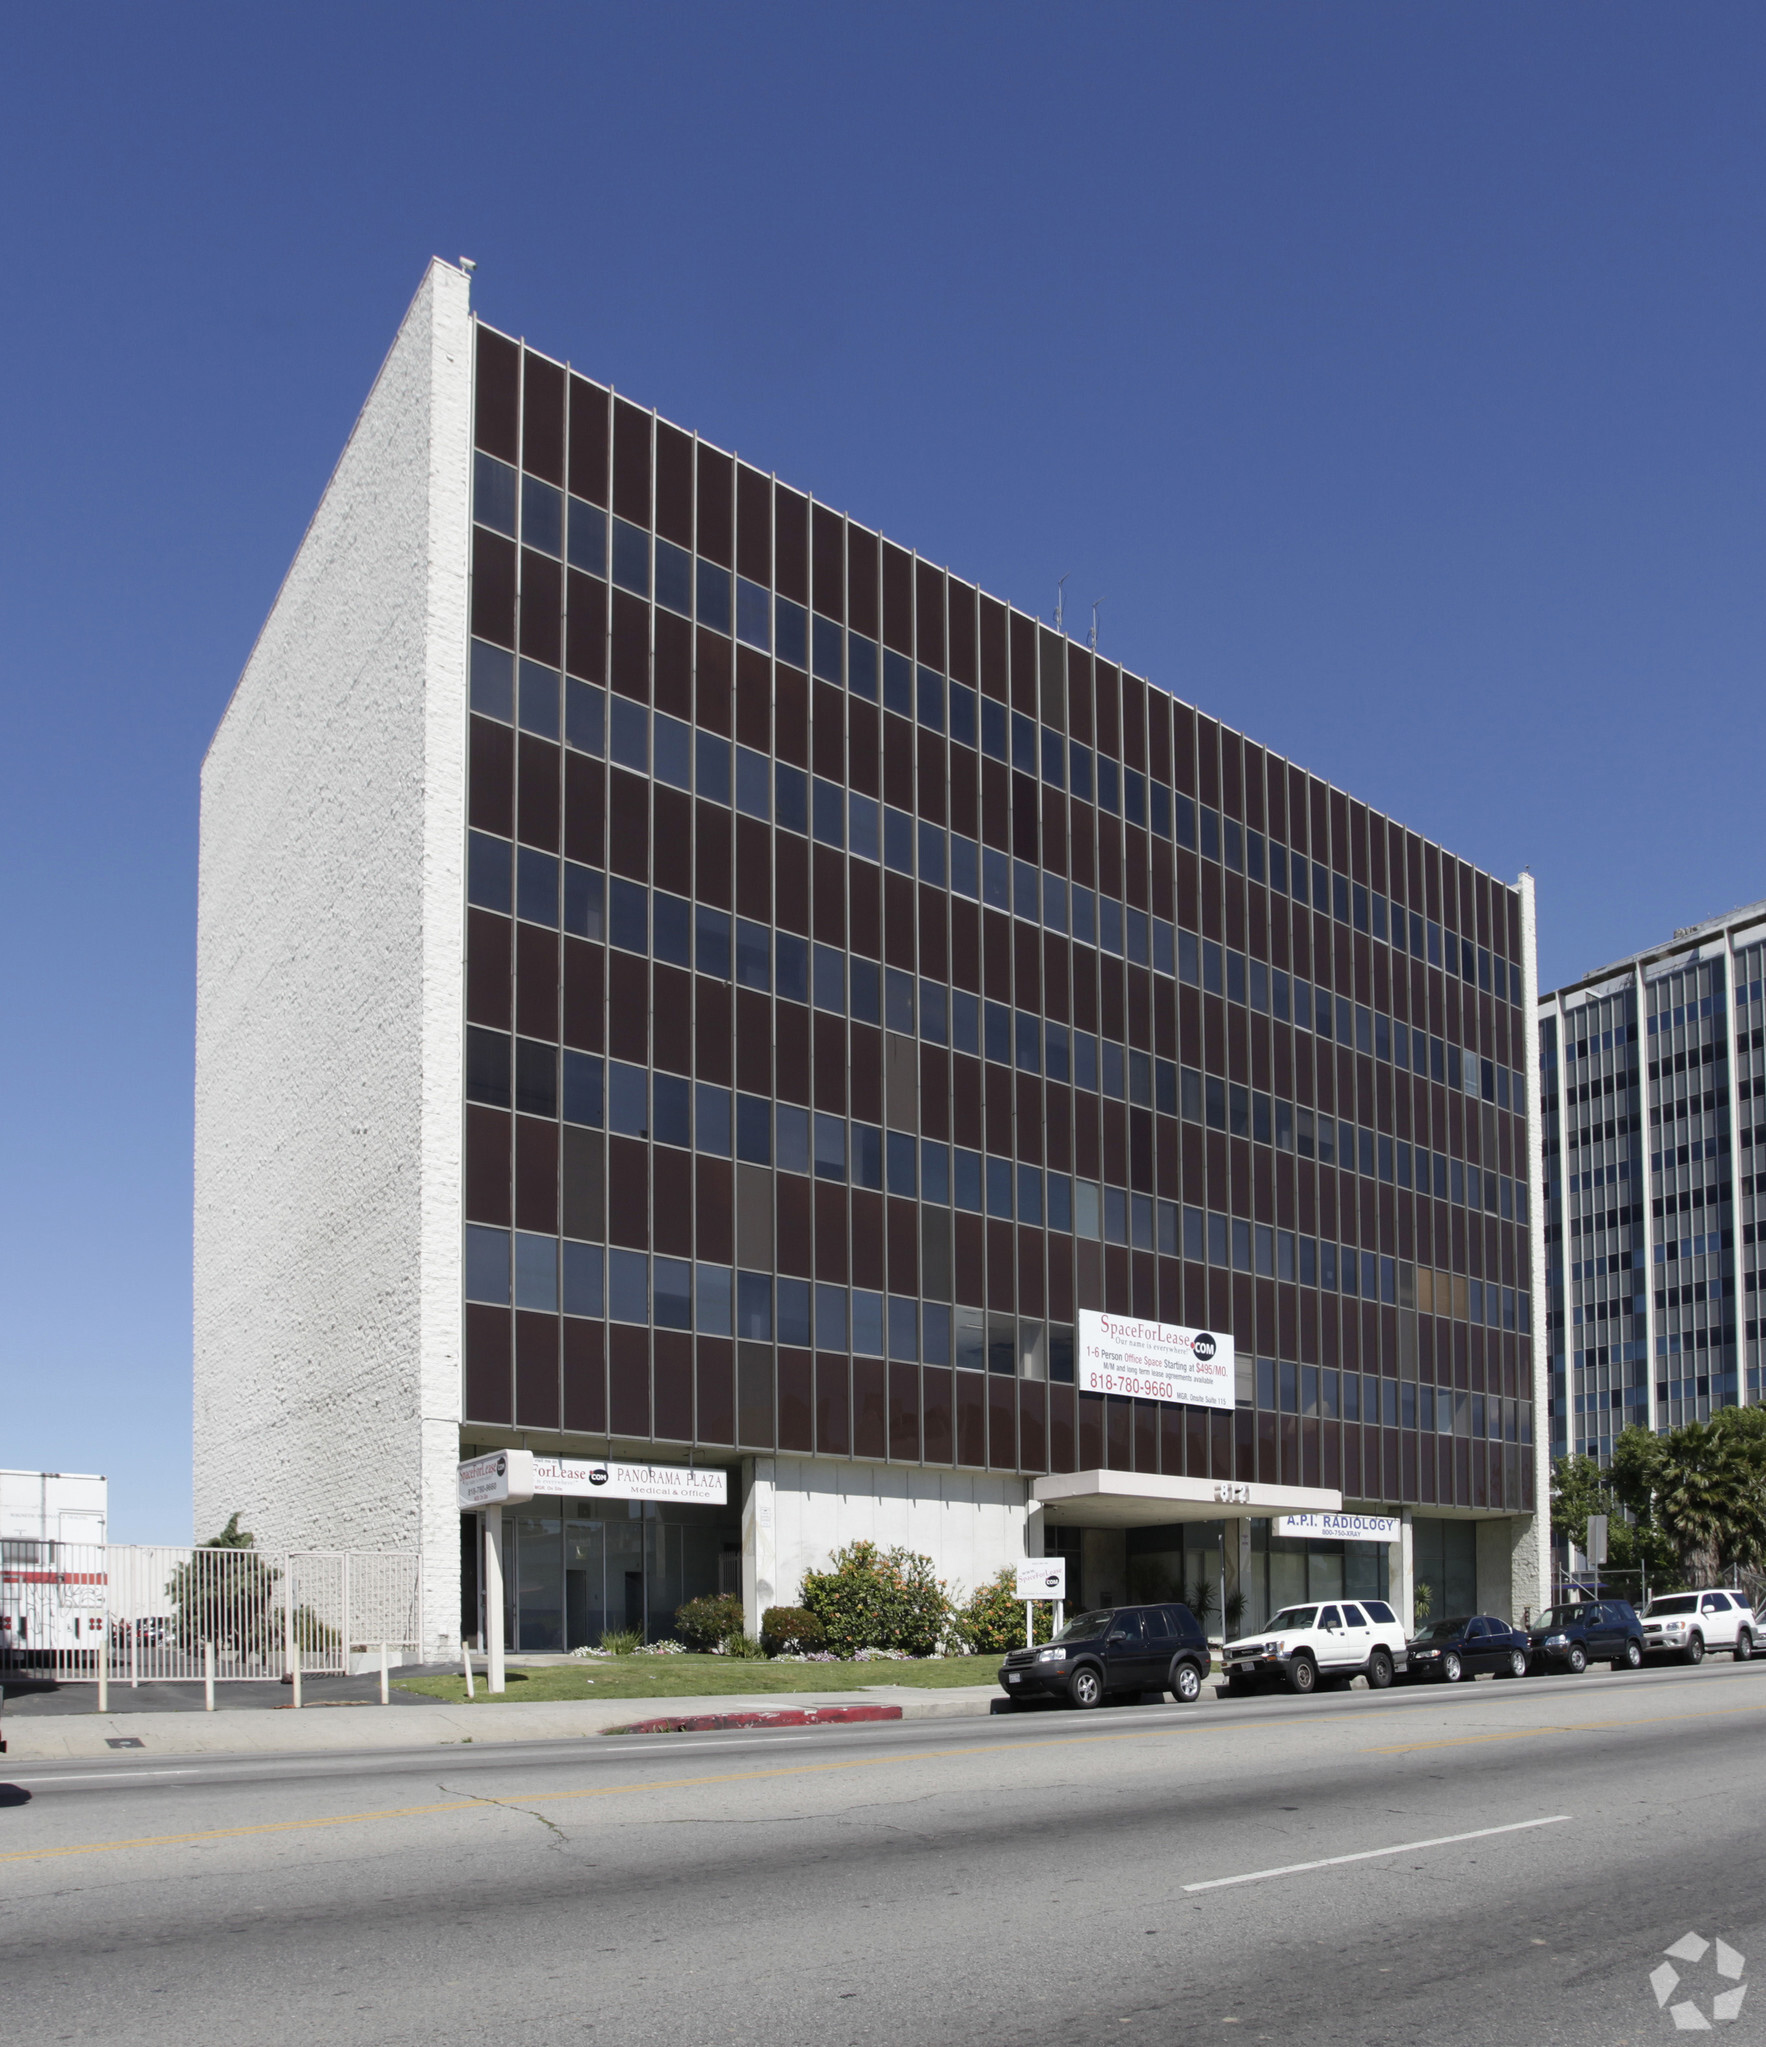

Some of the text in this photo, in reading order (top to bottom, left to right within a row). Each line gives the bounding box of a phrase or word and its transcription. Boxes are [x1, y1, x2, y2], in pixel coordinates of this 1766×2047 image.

[1115, 1336, 1128, 1345] Our
[1129, 1340, 1145, 1349] name
[1087, 1346, 1099, 1358] 1-6
[1101, 1349, 1123, 1361] Person
[1124, 1353, 1142, 1365] Office
[1144, 1356, 1163, 1367] Space
[1164, 1359, 1187, 1373] Starting
[1189, 1363, 1195, 1372] at
[1127, 1366, 1137, 1375] long
[1139, 1367, 1150, 1375] term
[1151, 1370, 1164, 1378] lease
[1165, 1372, 1192, 1381] agreements
[1194, 1376, 1214, 1384] available
[1090, 1372, 1173, 1398] 818-780-9660
[1190, 1393, 1204, 1402] Onsite
[1205, 1395, 1217, 1404] Suite
[617, 1467, 723, 1489] PANORAMA PLAZA
[630, 1486, 671, 1496] Medical
[681, 1489, 711, 1498] Office
[1287, 1514, 1394, 1532] A.P.I. RADIOLOGY
[1322, 1528, 1362, 1537] 800-750-XRAY
